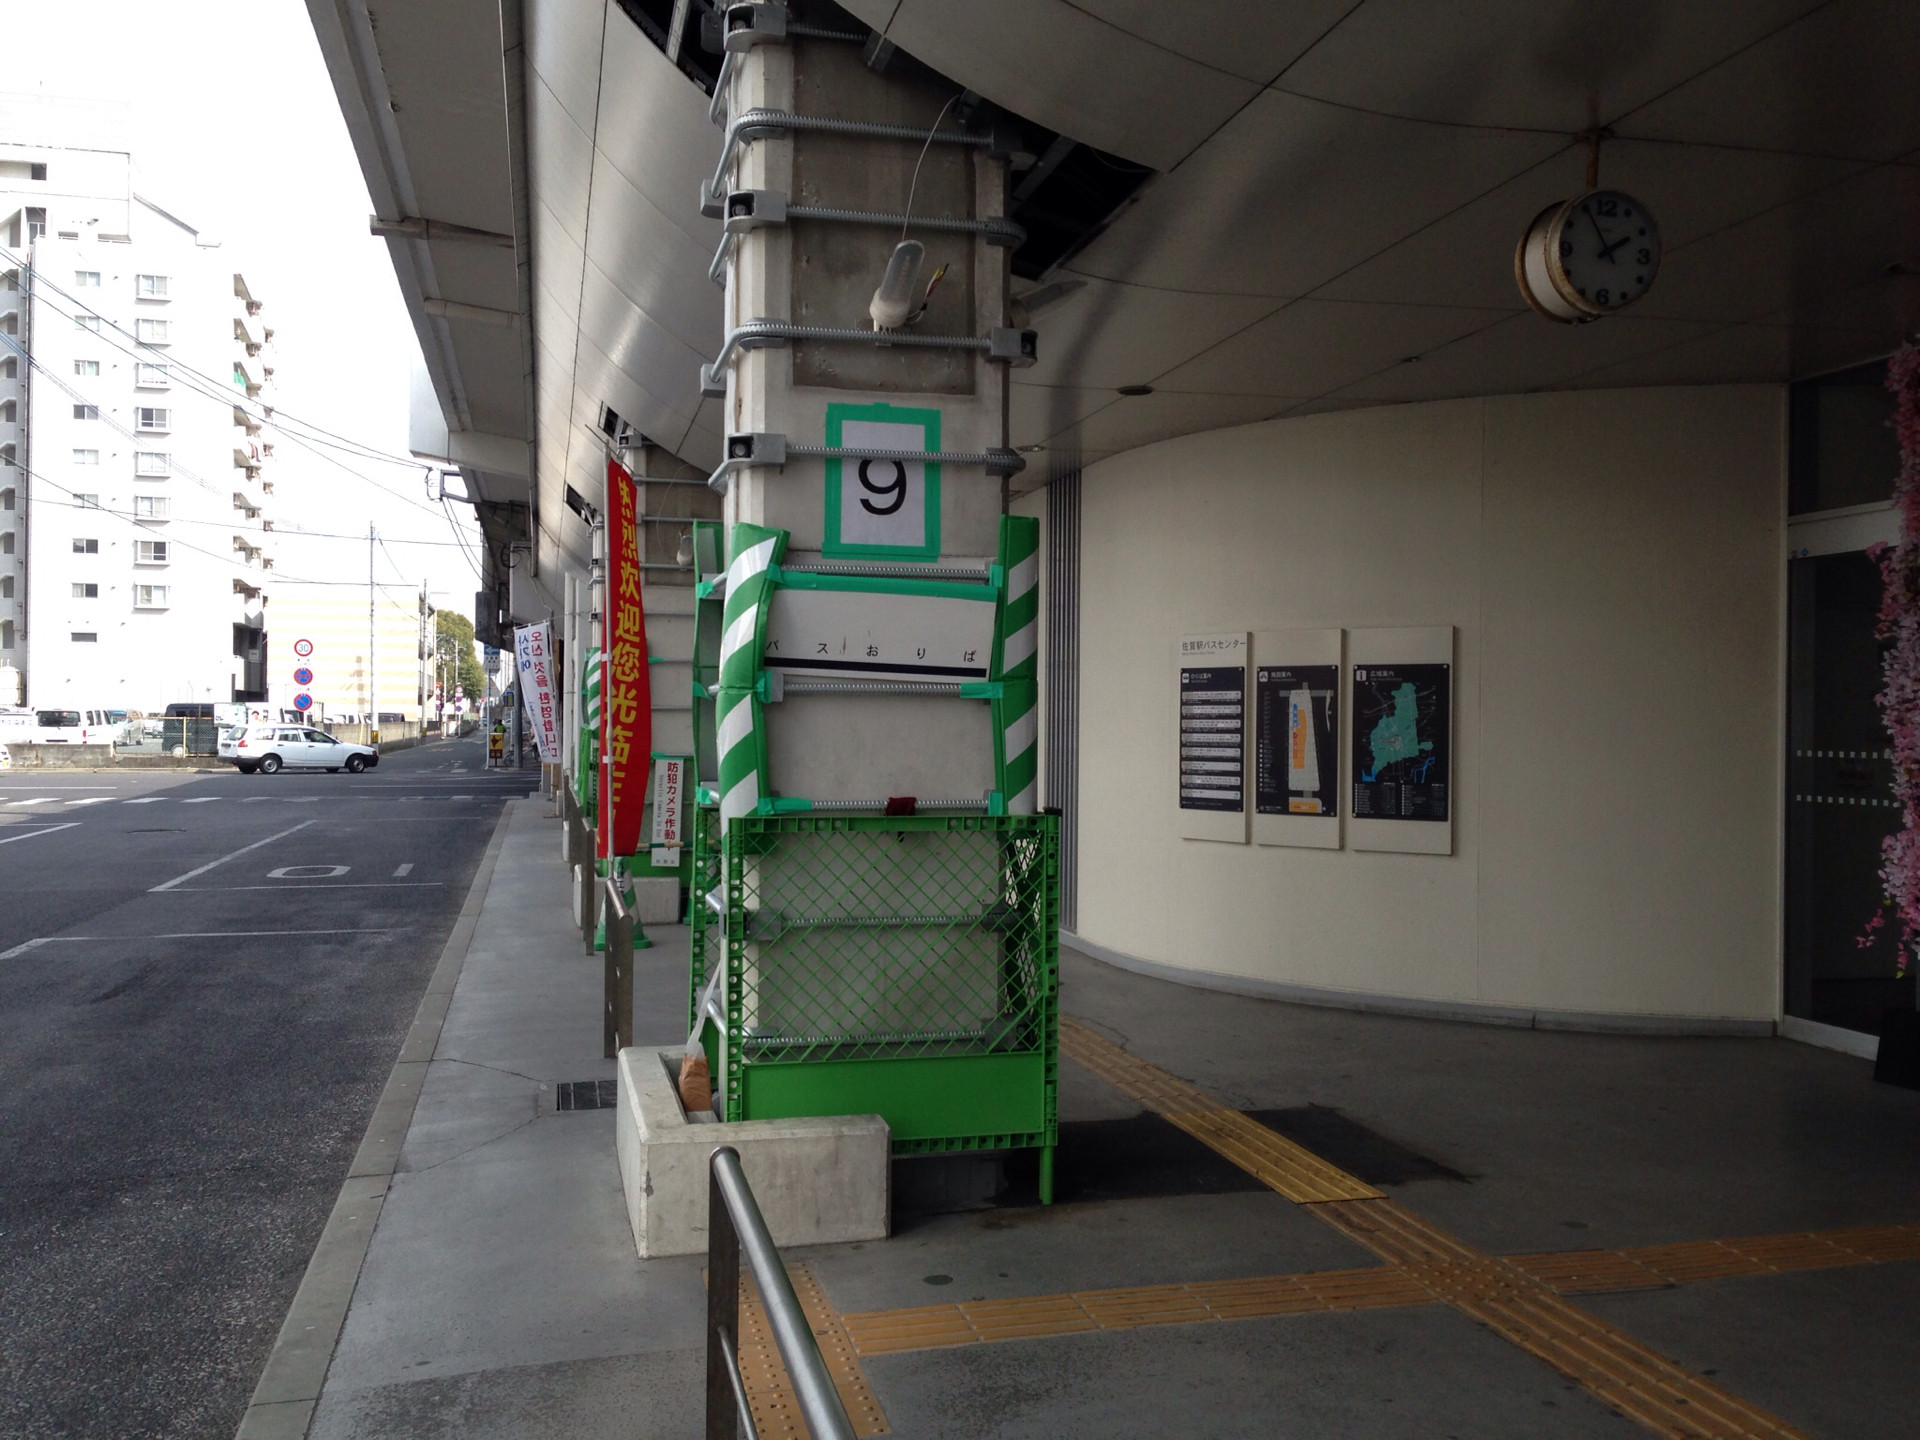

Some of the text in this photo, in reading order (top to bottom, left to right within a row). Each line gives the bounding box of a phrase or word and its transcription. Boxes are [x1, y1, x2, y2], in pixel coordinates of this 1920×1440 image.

[1596, 199, 1618, 217] 12
[1637, 249, 1650, 265] 3
[1596, 288, 1609, 305] 6
[858, 458, 907, 516] 9
[298, 643, 310, 653] 30
[766, 639, 977, 664] バスおりば
[1181, 639, 1246, 652] 佐賀駅バスセンター
